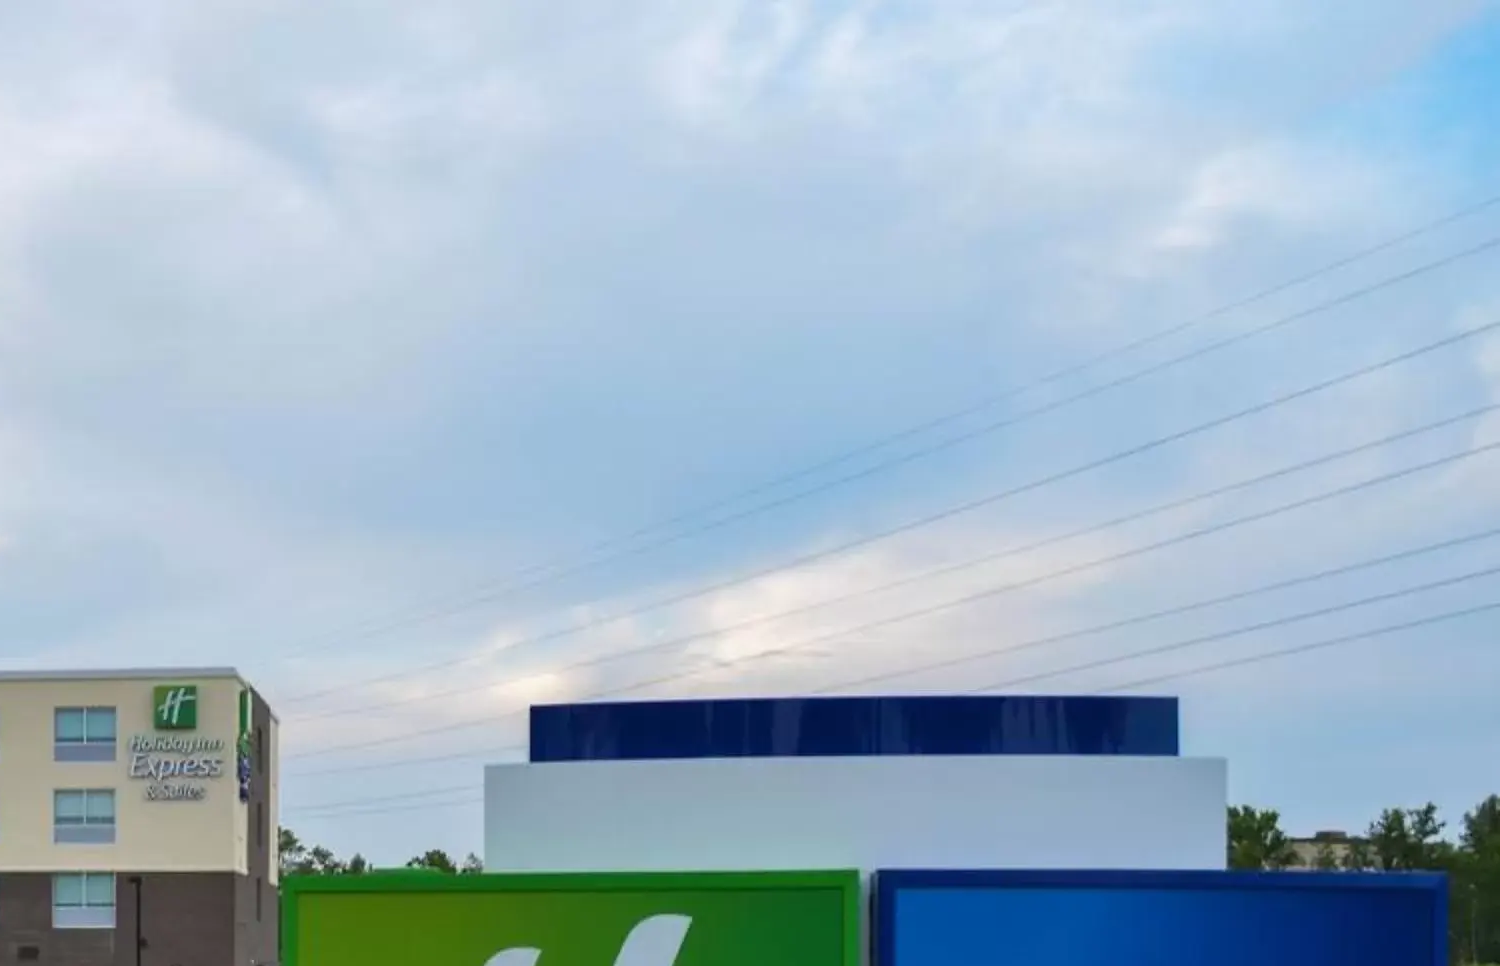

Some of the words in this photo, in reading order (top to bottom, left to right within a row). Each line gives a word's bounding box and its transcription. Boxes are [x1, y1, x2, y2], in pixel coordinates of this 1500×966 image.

[130, 735, 193, 753] Holiday
[194, 737, 225, 751] Inn
[130, 753, 224, 782] Express
[146, 783, 159, 800] &
[162, 782, 206, 800] Suites
